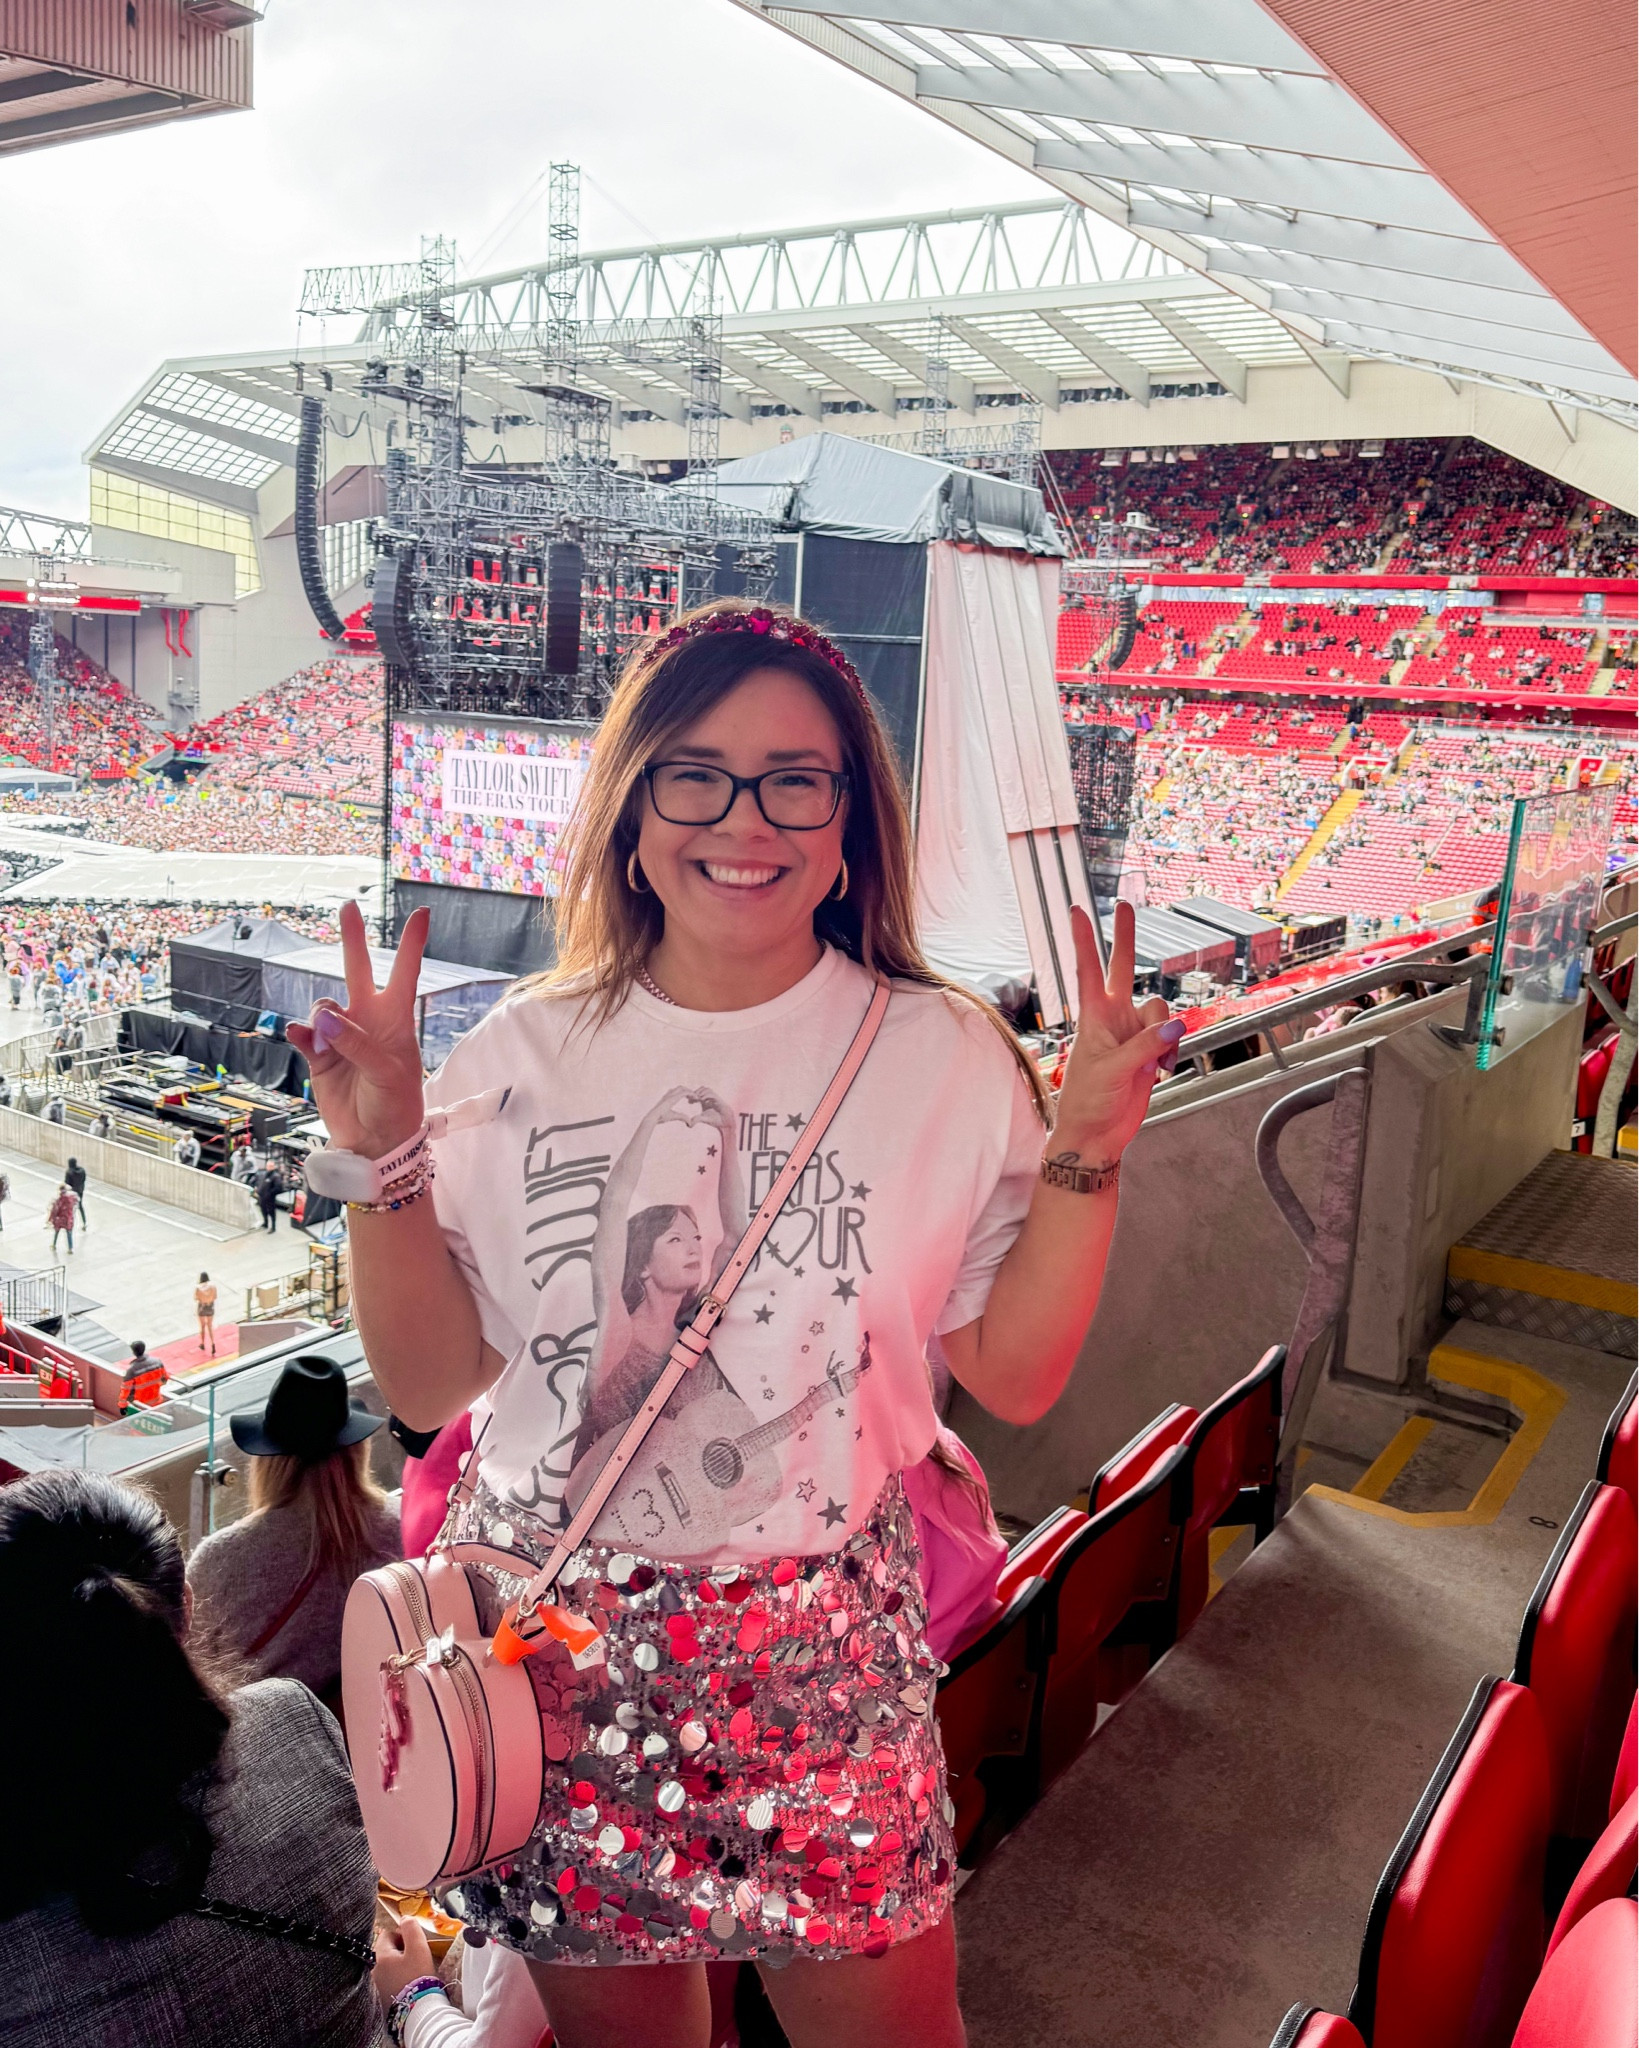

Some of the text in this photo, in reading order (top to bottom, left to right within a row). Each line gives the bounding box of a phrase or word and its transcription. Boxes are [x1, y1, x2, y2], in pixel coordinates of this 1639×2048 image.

[452, 758, 571, 798] TAYLOR SWIFT
[451, 789, 570, 815] THE ERAS TOUR
[739, 1113, 778, 1151] THE
[749, 1150, 844, 1208] ERAS
